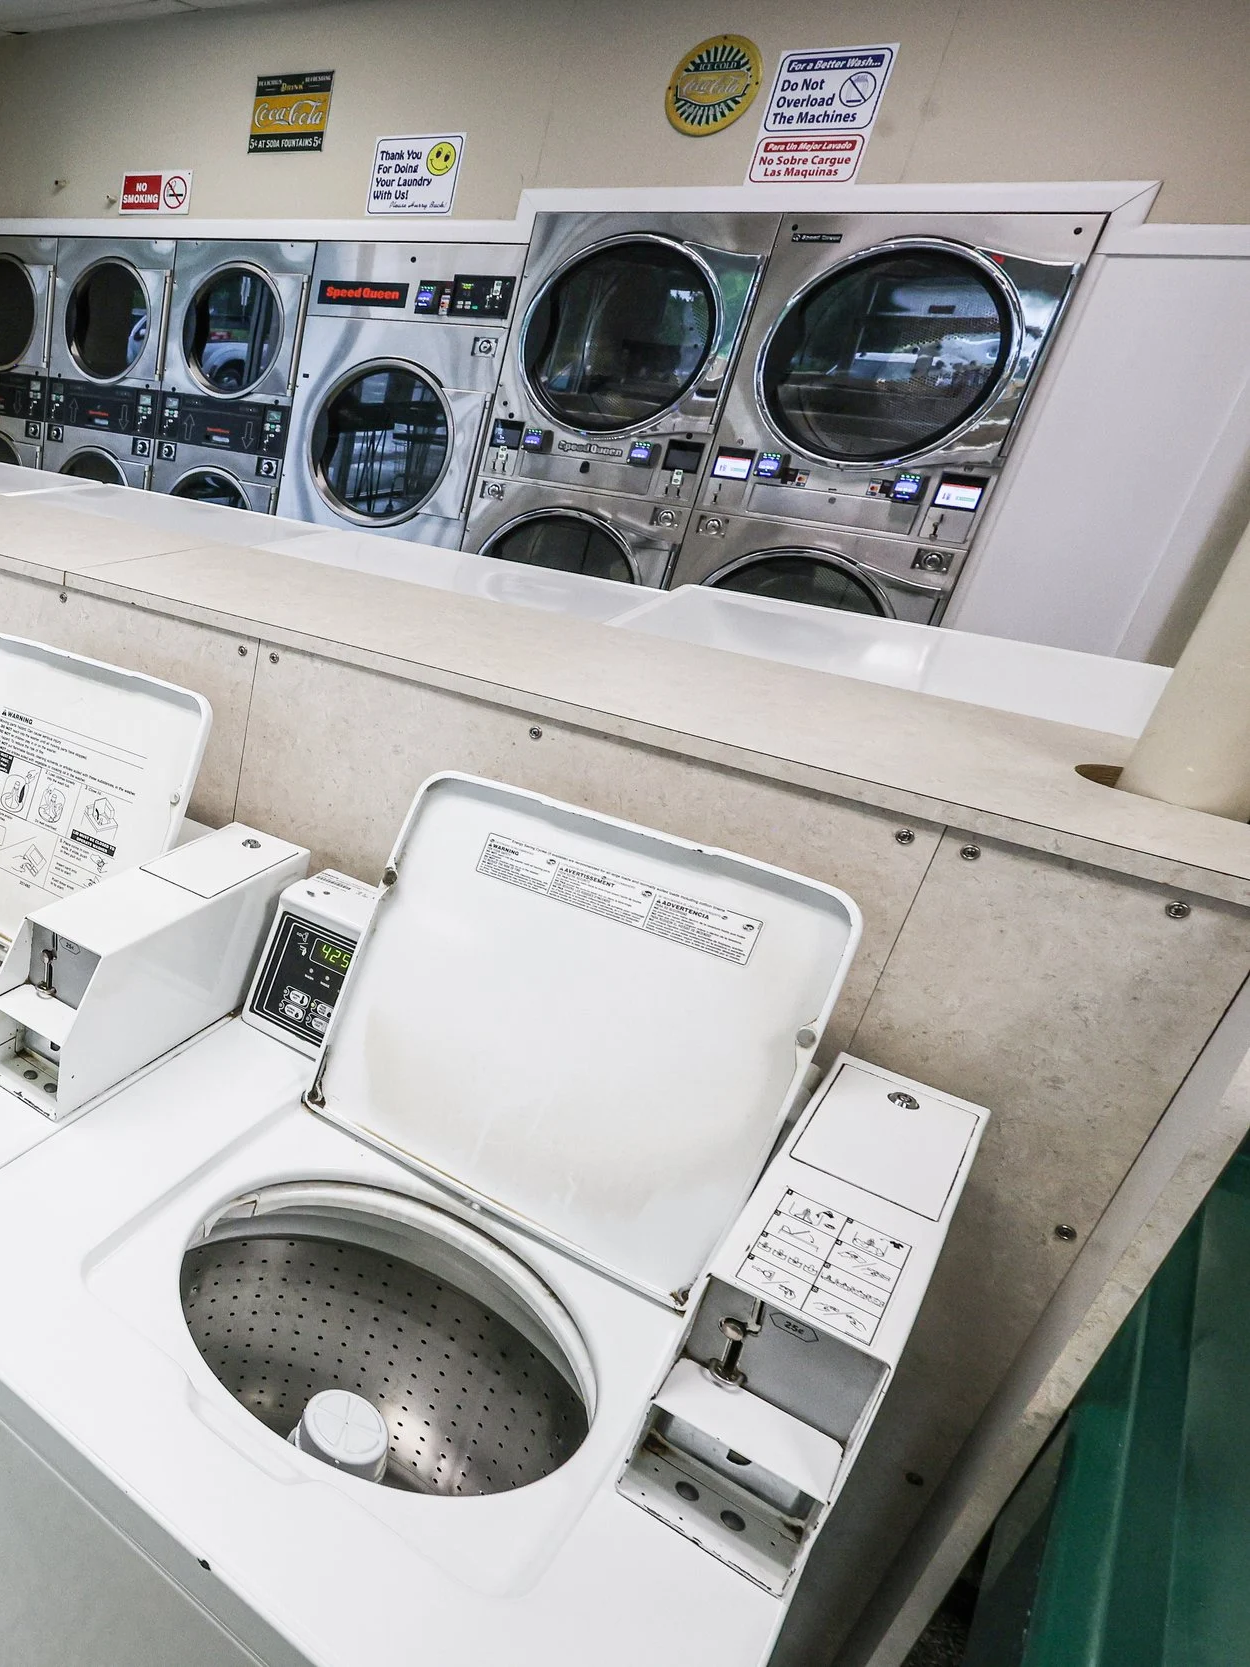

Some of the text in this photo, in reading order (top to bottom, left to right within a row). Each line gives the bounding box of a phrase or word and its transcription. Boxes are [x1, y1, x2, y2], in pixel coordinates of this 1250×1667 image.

[714, 62, 737, 70] COLD
[790, 62, 806, 71] For
[814, 60, 846, 69] Better
[846, 57, 881, 68] Wash...
[781, 78, 825, 92] Do Not
[776, 93, 836, 108] Overload
[772, 110, 857, 124] The Machines
[258, 140, 265, 148] AT
[266, 139, 280, 148] SODA
[281, 138, 312, 147] FOUNTAINS
[797, 142, 822, 151] Mejor
[822, 141, 852, 149] Lavado
[380, 150, 422, 160] Thank You
[758, 155, 851, 166] No Sobre Cargue
[378, 163, 419, 174] For Doing
[763, 167, 838, 178] Las Maquinas
[136, 182, 147, 192] NO
[375, 176, 432, 187] Your Laundry
[123, 194, 158, 204] SMOKING
[373, 190, 409, 200] With Us!
[326, 286, 400, 299] Speed Queen
[7, 711, 33, 725] WARNING
[493, 844, 520, 856] WARNING
[564, 868, 615, 888] AVERTISSEMENT
[662, 900, 710, 920] ADVERTENCIA
